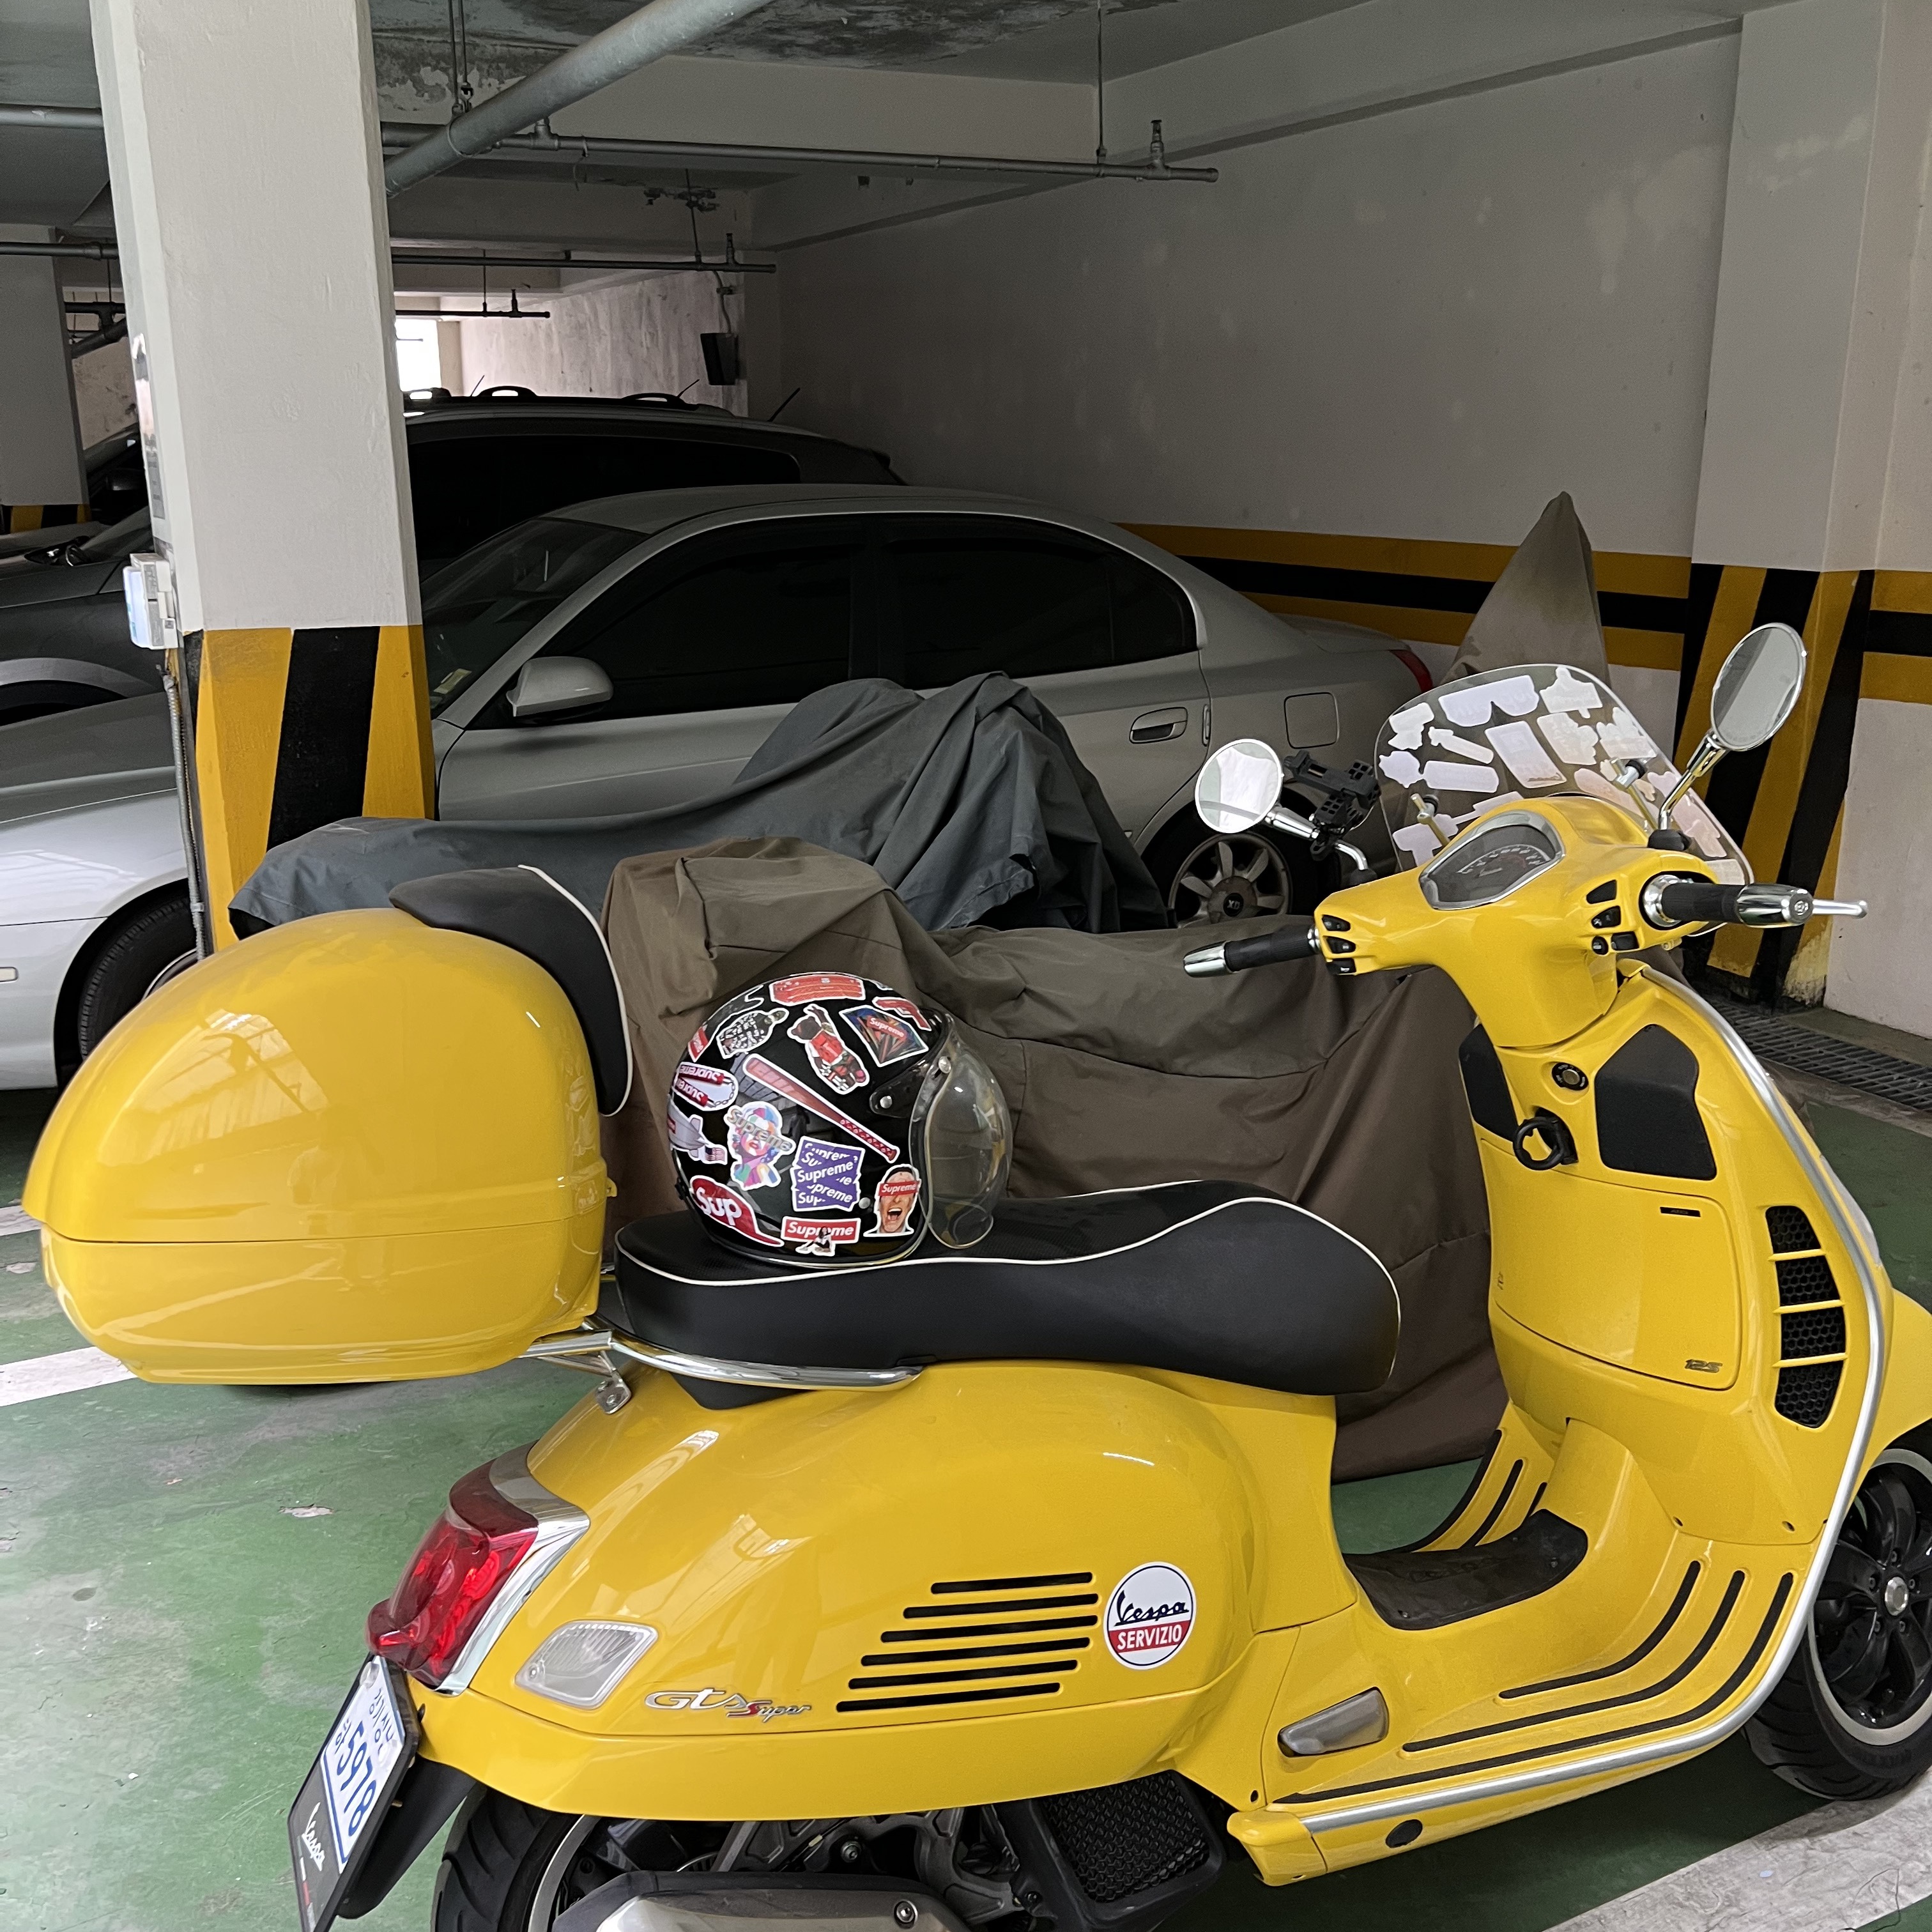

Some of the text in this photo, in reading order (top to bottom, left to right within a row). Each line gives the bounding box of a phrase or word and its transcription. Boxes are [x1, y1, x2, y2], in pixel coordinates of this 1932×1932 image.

[870, 1017, 904, 1038] Supreme
[726, 1108, 793, 1152] Supreme
[797, 1162, 854, 1183] Supreme
[882, 1184, 916, 1195] Supreme
[696, 1187, 742, 1226] Sup
[1114, 1590, 1190, 1627] Vespa
[1117, 1625, 1183, 1650] SERVIZIO
[337, 1720, 377, 1837] 5978
[301, 1802, 325, 1871] Vespa
